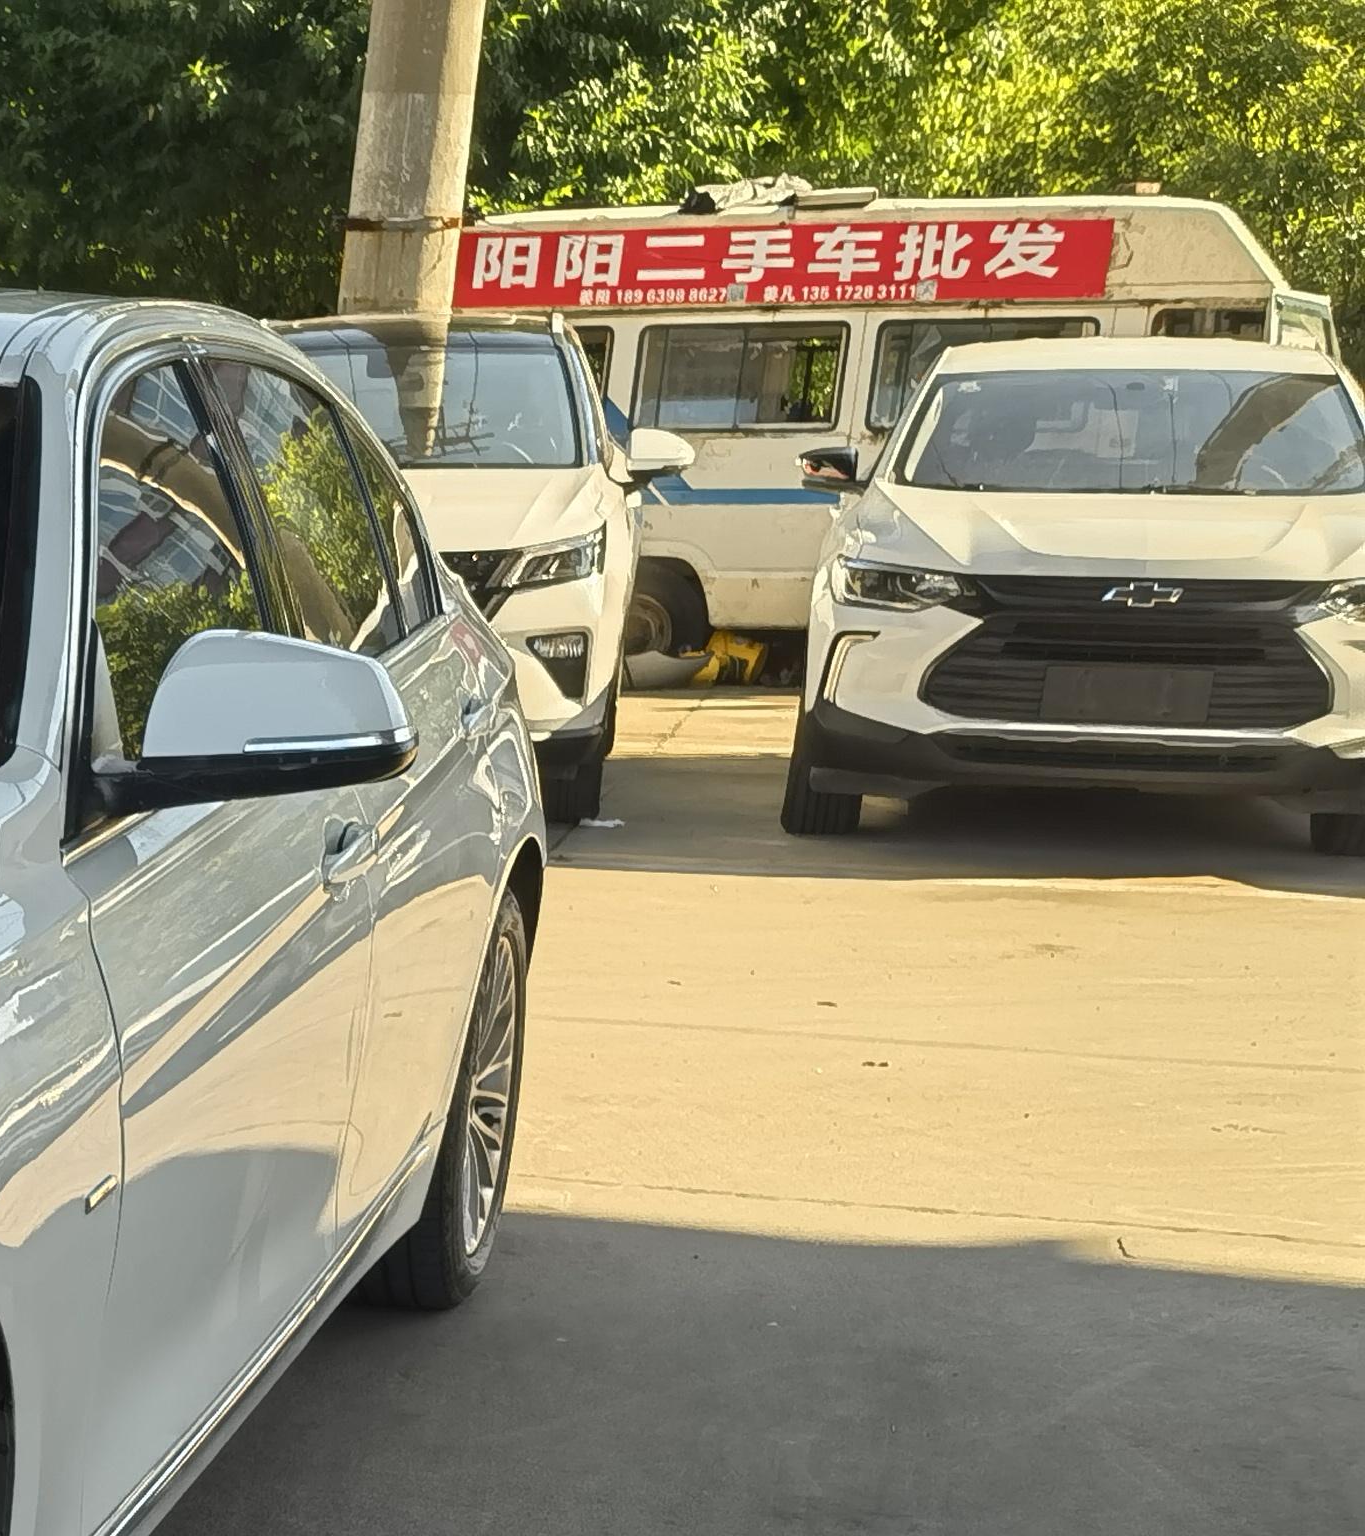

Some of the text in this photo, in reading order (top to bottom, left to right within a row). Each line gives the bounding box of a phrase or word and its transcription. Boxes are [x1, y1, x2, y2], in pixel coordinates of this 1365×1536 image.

[472, 223, 1065, 289] 阳阳二手车批发
